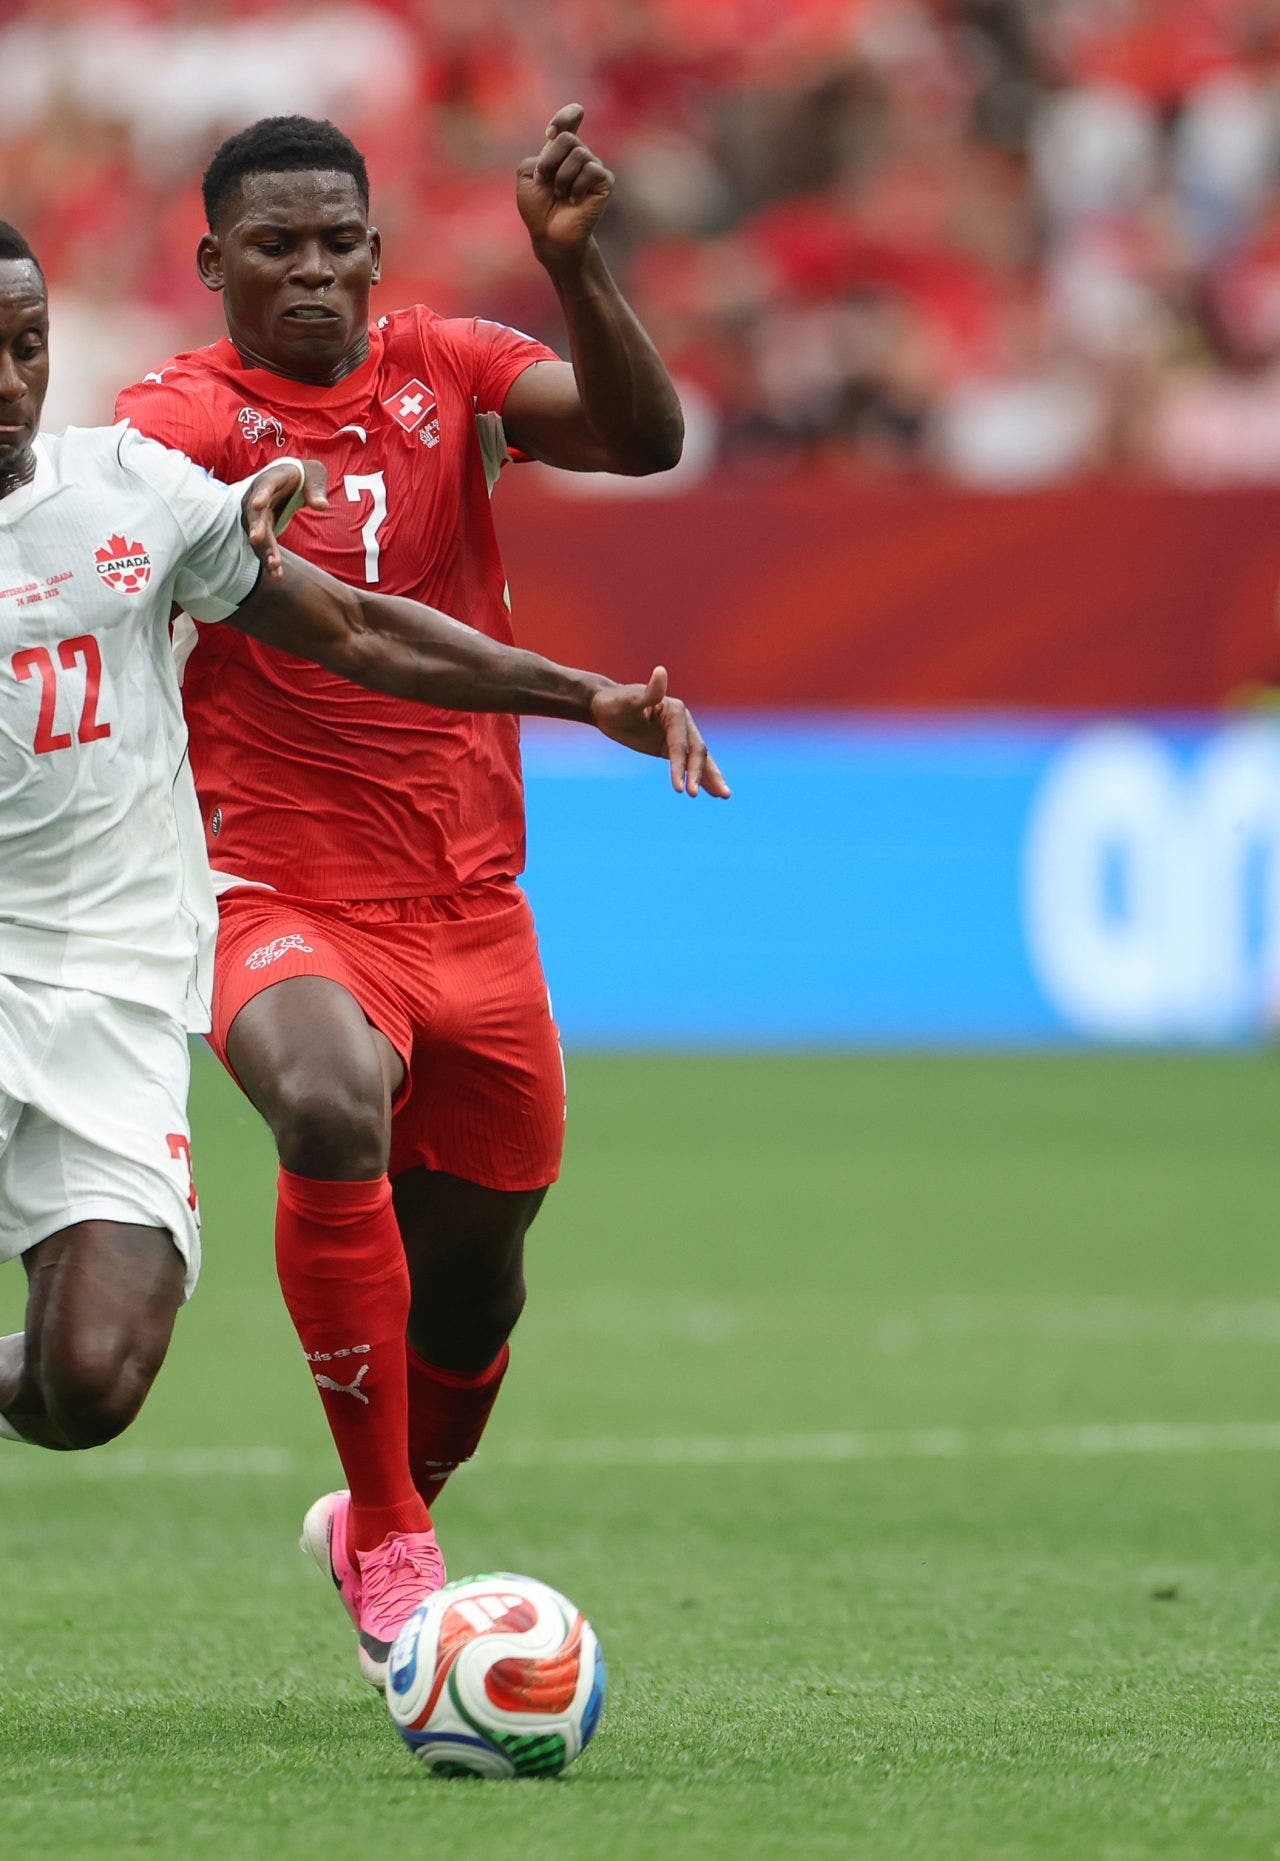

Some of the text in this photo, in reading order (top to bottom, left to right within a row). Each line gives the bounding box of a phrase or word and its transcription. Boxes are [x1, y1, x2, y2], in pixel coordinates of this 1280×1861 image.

[96, 555, 151, 574] CANADA
[343, 470, 388, 583] 7
[11, 634, 111, 755] 22
